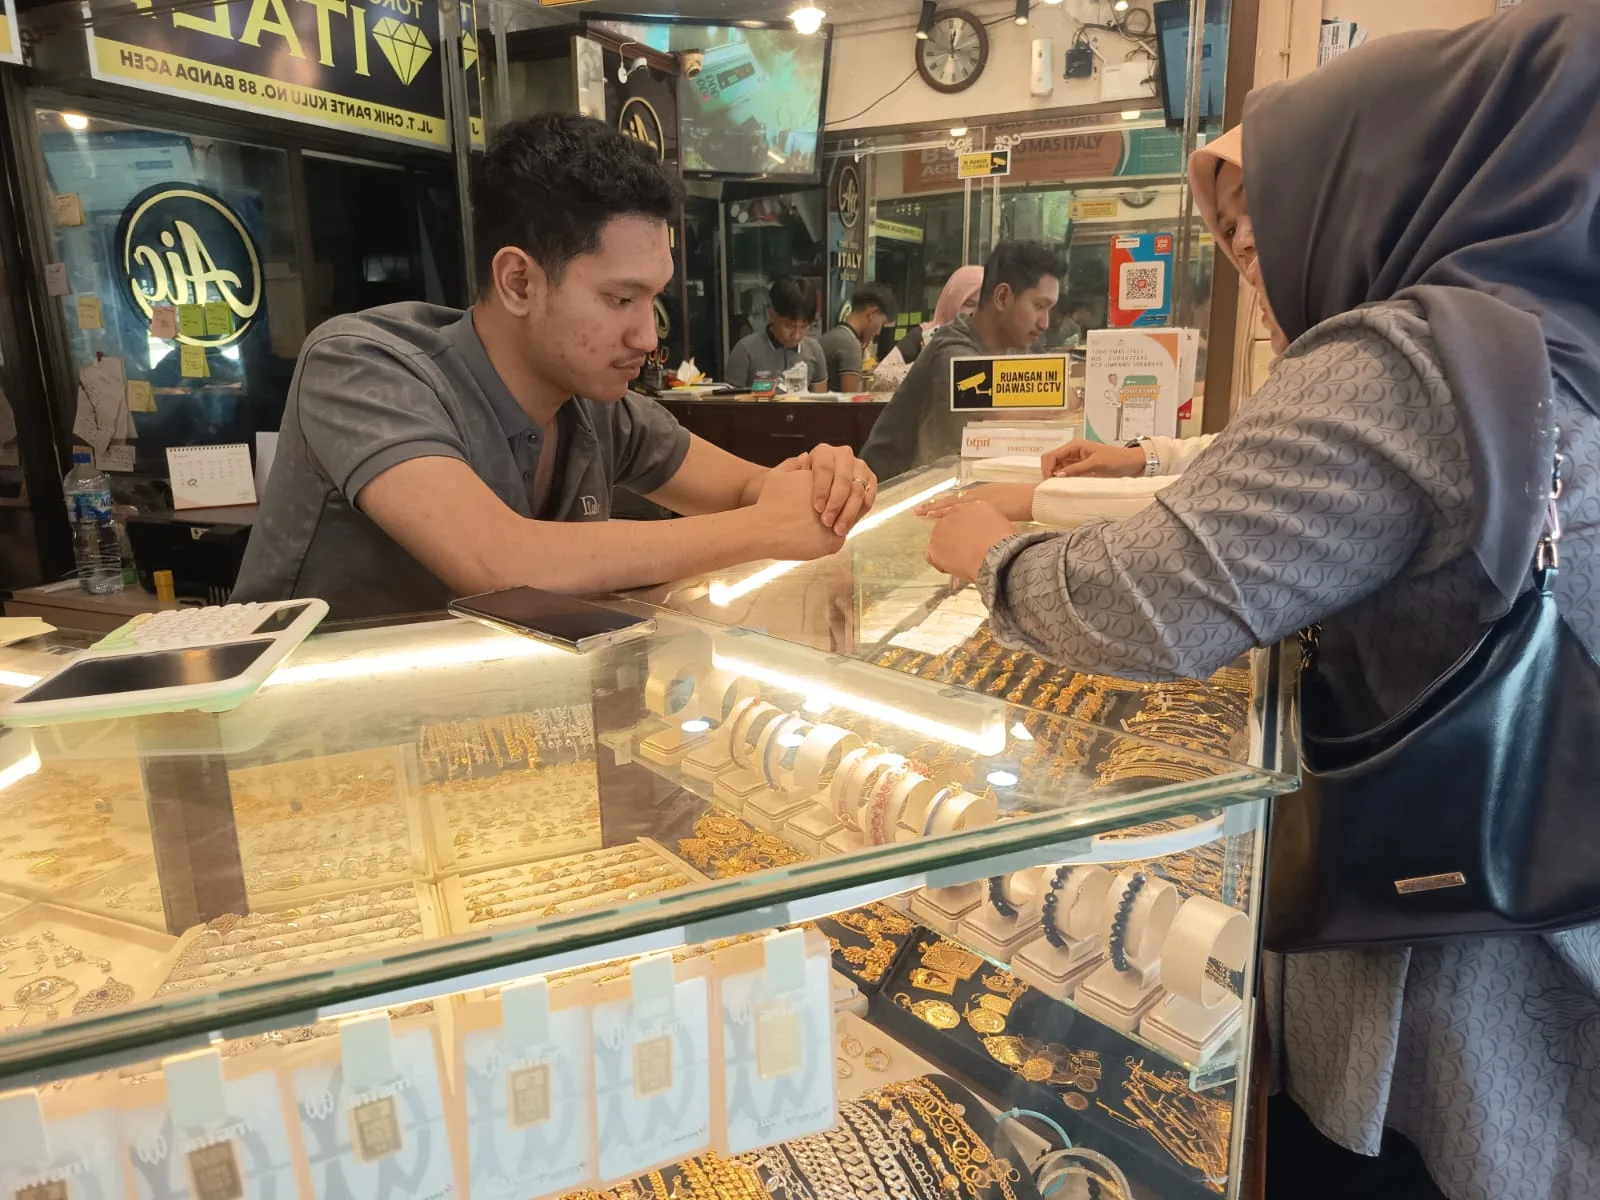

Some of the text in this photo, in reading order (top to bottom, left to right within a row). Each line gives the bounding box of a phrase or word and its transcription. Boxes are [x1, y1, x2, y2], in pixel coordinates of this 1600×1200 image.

[1062, 134, 1104, 151] ITALY
[837, 252, 862, 269] ITALY
[1000, 370, 1058, 383] RUANGAN INI
[996, 381, 1062, 394] DIAWASI CCTV
